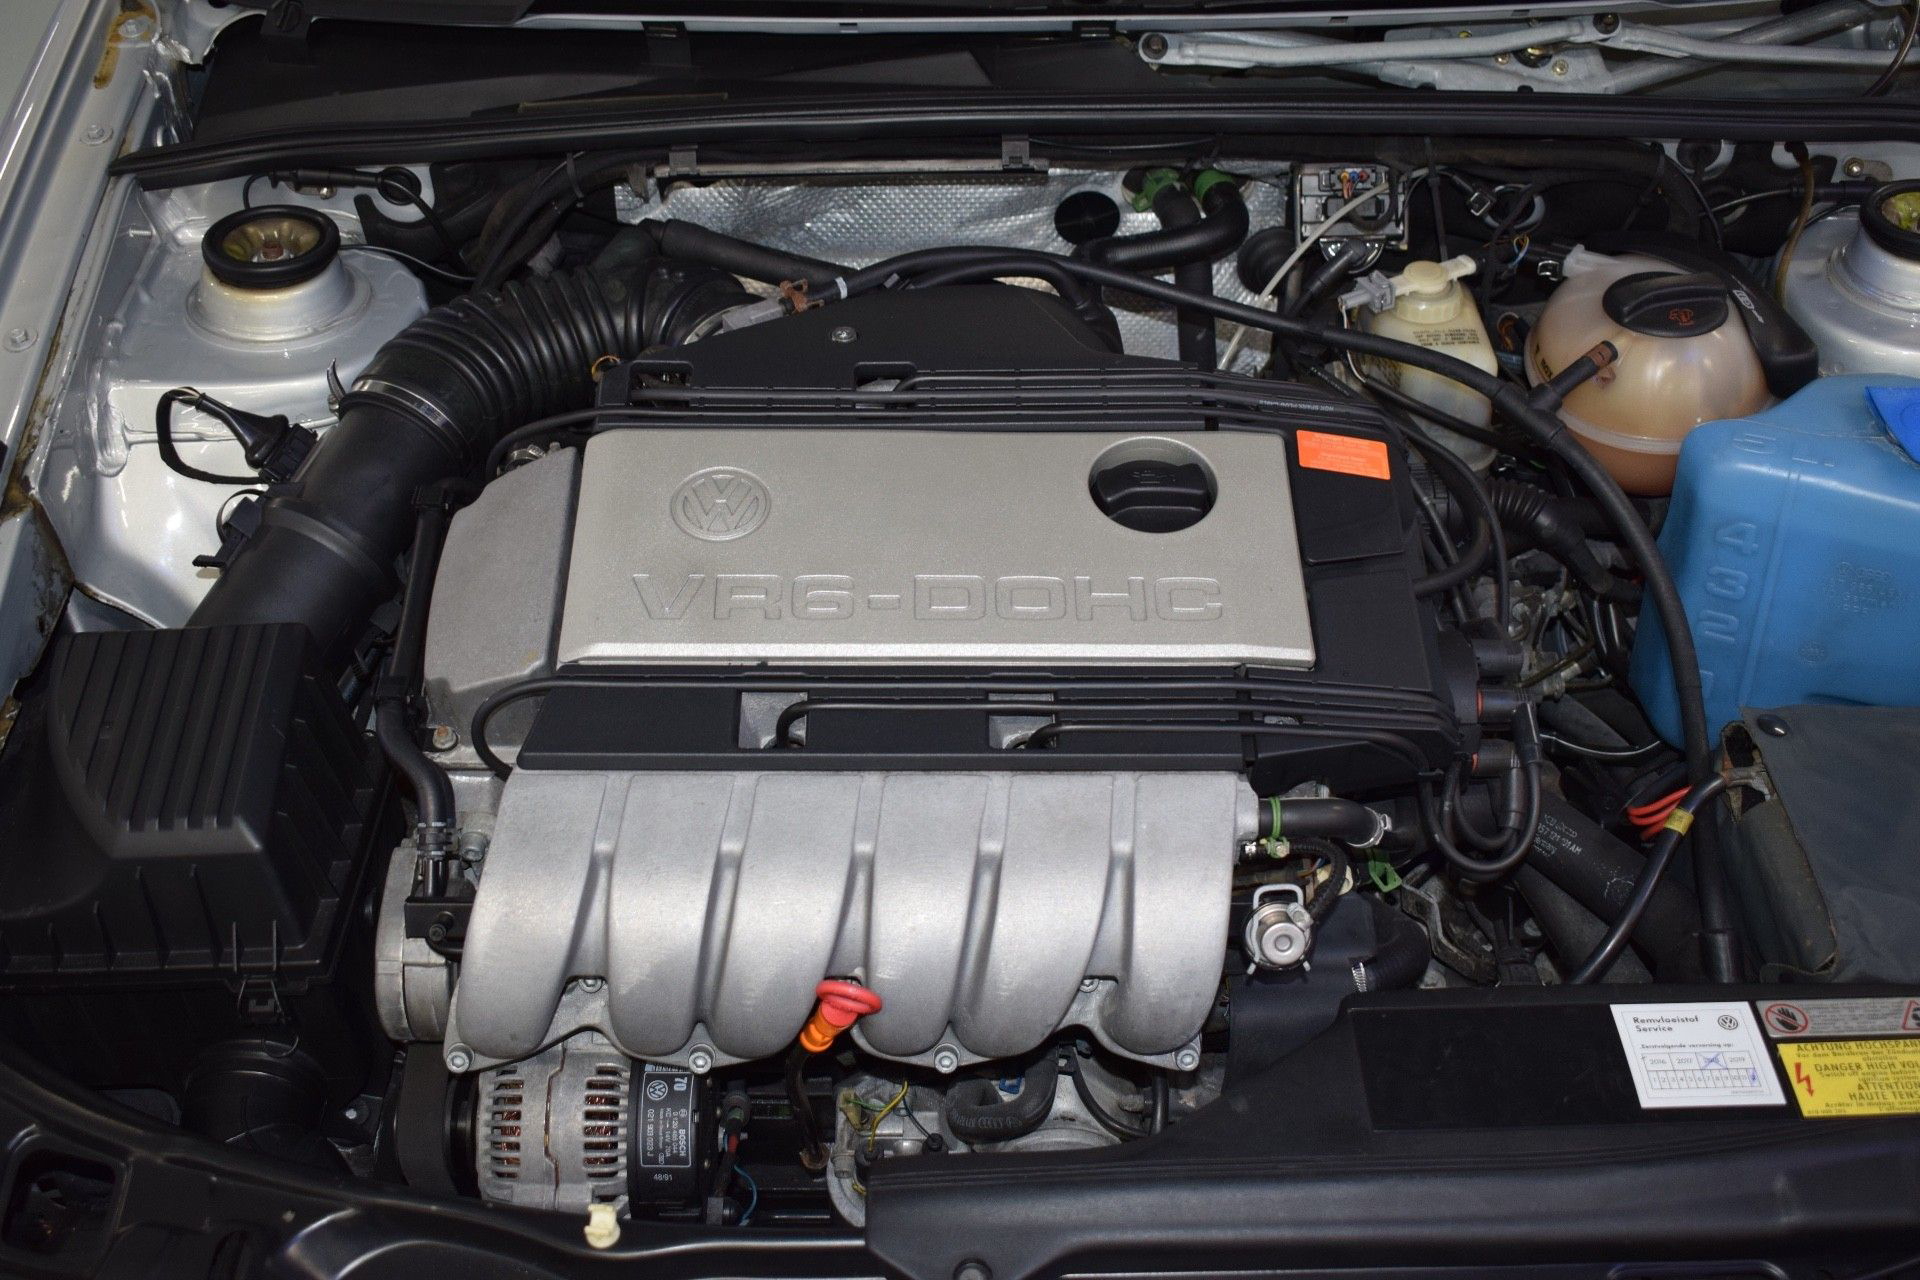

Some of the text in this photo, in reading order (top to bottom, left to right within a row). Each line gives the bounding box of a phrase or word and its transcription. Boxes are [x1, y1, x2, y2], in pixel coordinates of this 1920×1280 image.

[632, 573, 1223, 622] VR6-DOHC
[1797, 1040, 1920, 1051] ACHTUNG HOCHSPAN
[1814, 1062, 1862, 1072] DANGER
[1866, 1061, 1896, 1070] HIGH
[674, 1076, 688, 1091] 70
[1849, 1092, 1888, 1100] HAUTE
[679, 1128, 687, 1157] BOSCH
